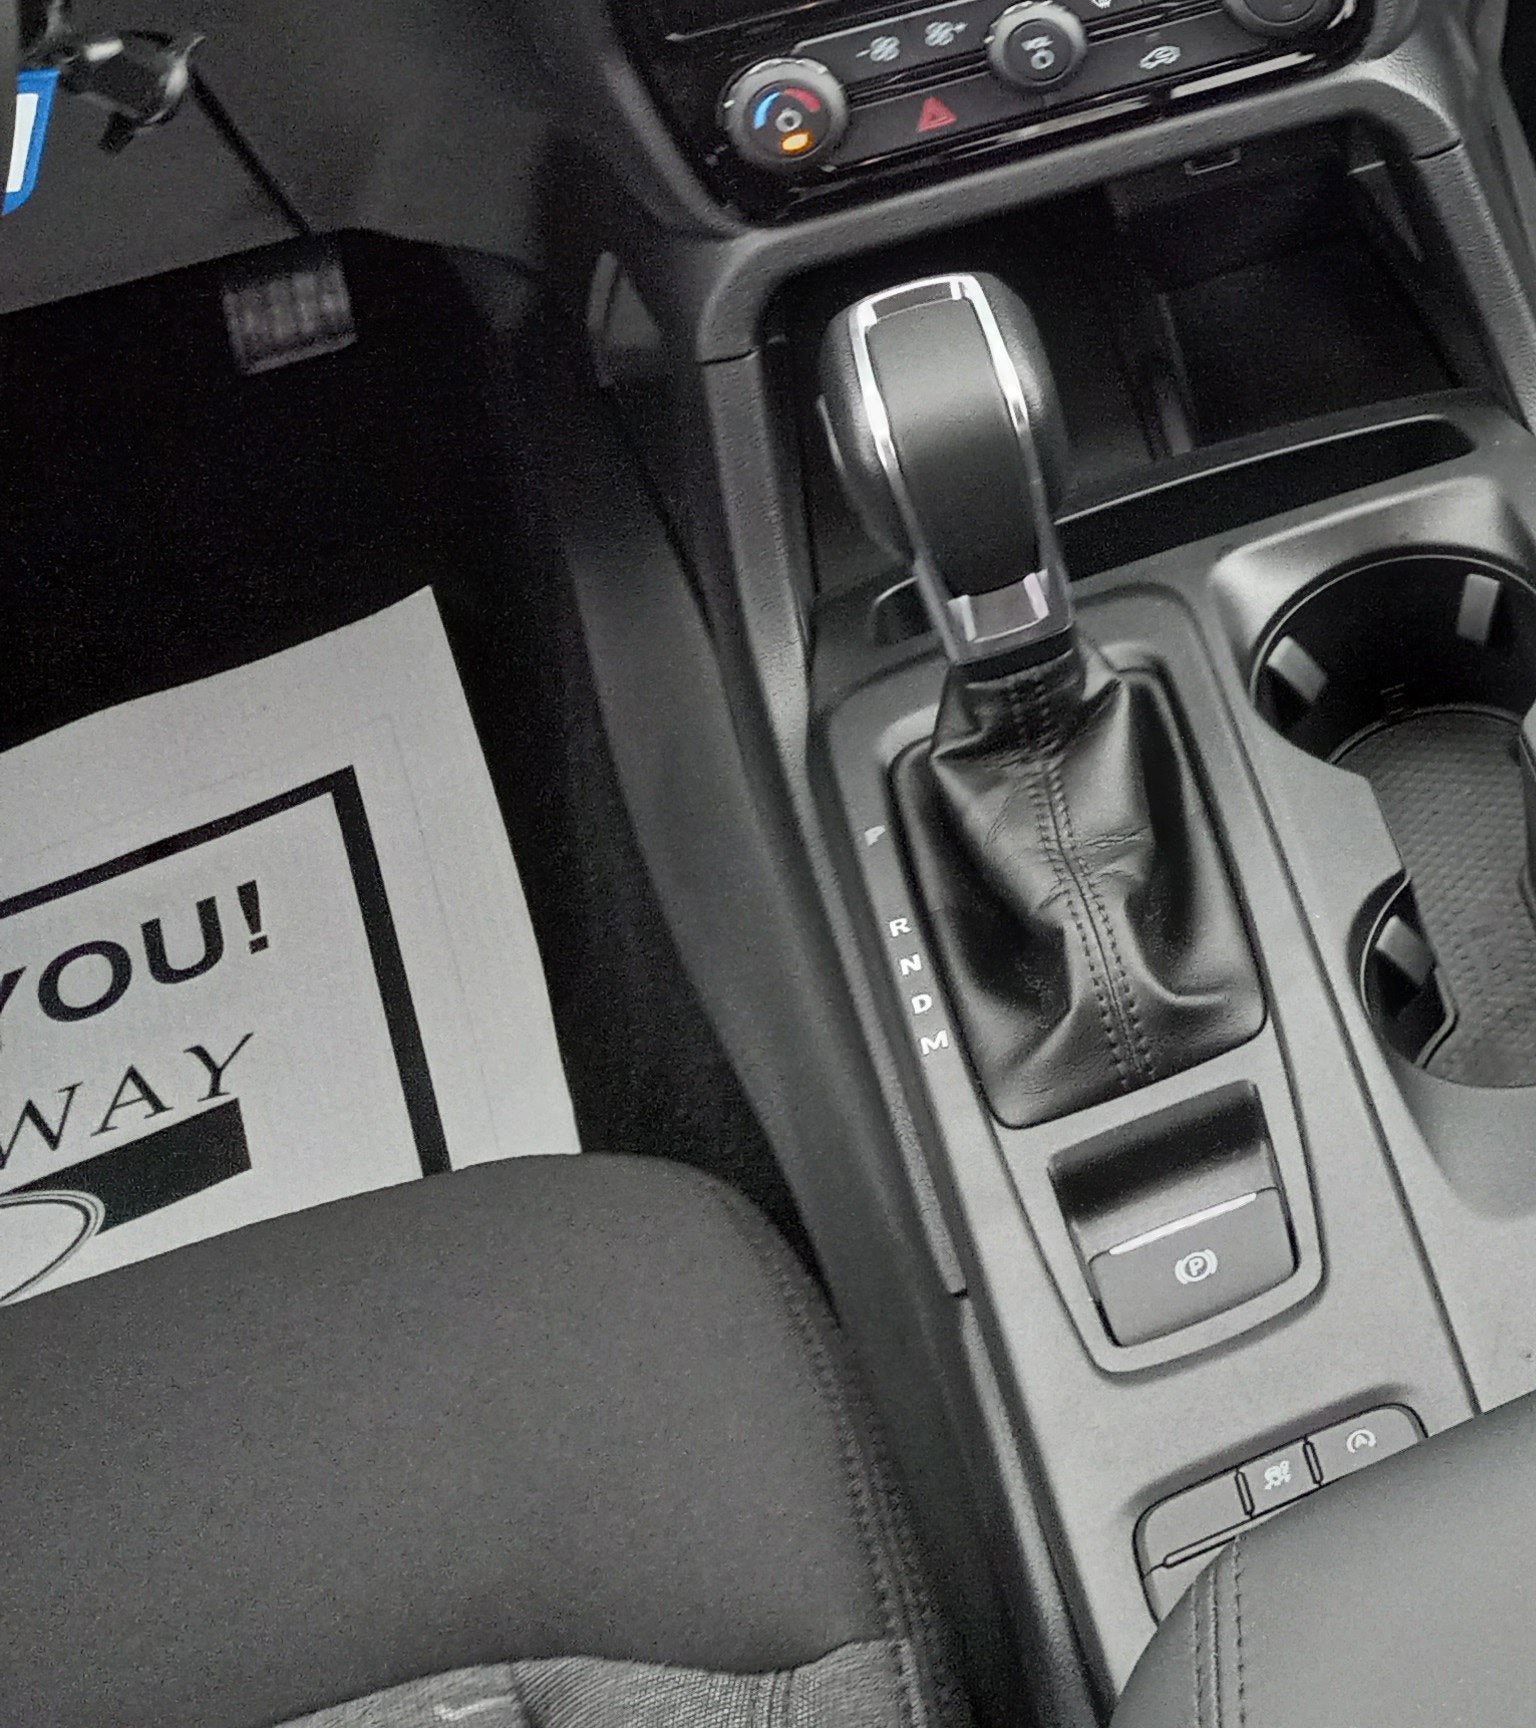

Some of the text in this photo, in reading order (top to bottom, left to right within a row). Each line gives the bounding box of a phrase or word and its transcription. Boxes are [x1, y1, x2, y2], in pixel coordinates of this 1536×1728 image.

[864, 824, 885, 846] P
[888, 917, 912, 938] R
[899, 954, 923, 975] N
[911, 994, 933, 1015] D
[919, 1029, 950, 1055] M
